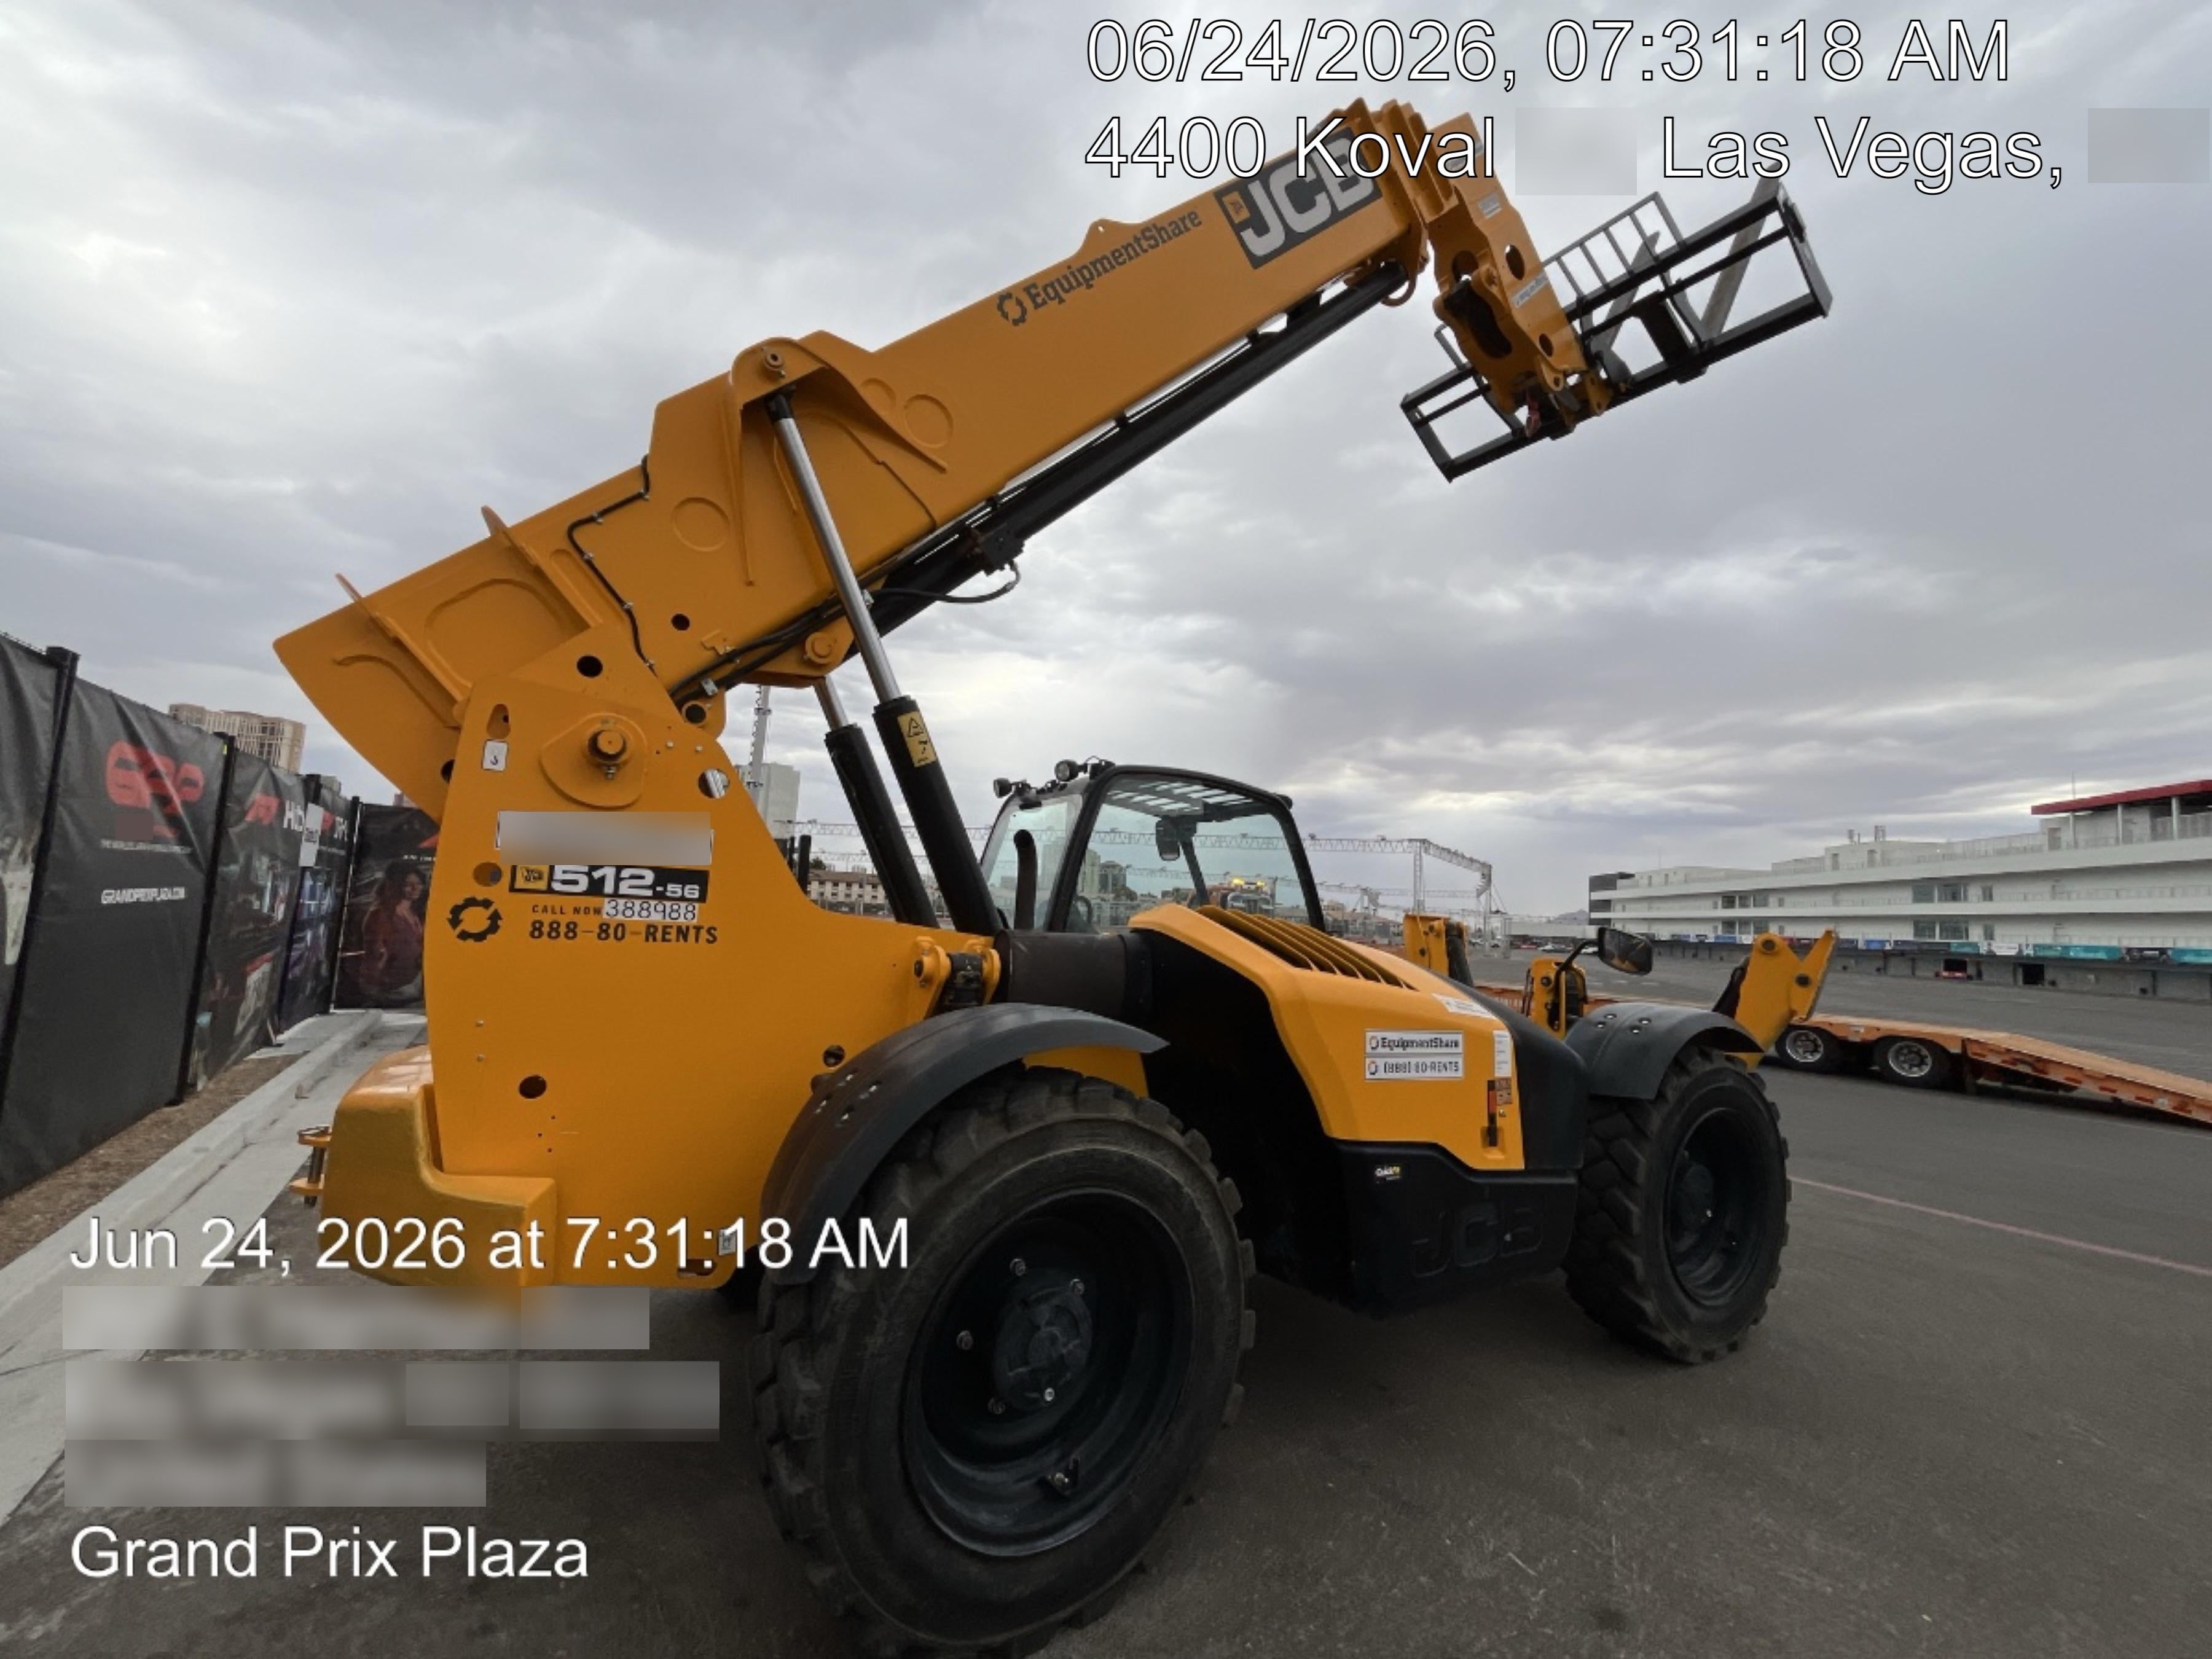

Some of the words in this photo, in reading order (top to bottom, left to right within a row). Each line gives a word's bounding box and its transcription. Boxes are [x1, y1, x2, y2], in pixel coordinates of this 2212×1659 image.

[1240, 136, 1375, 257] JCB
[1022, 208, 1202, 311] EquipmentShare
[551, 865, 700, 898] 512-56
[532, 904, 566, 915] CALL
[573, 906, 602, 916] NOW
[605, 899, 696, 920] 388988
[529, 919, 719, 944] 888-80-RENTS
[1381, 1037, 1459, 1051] EquipmentShare
